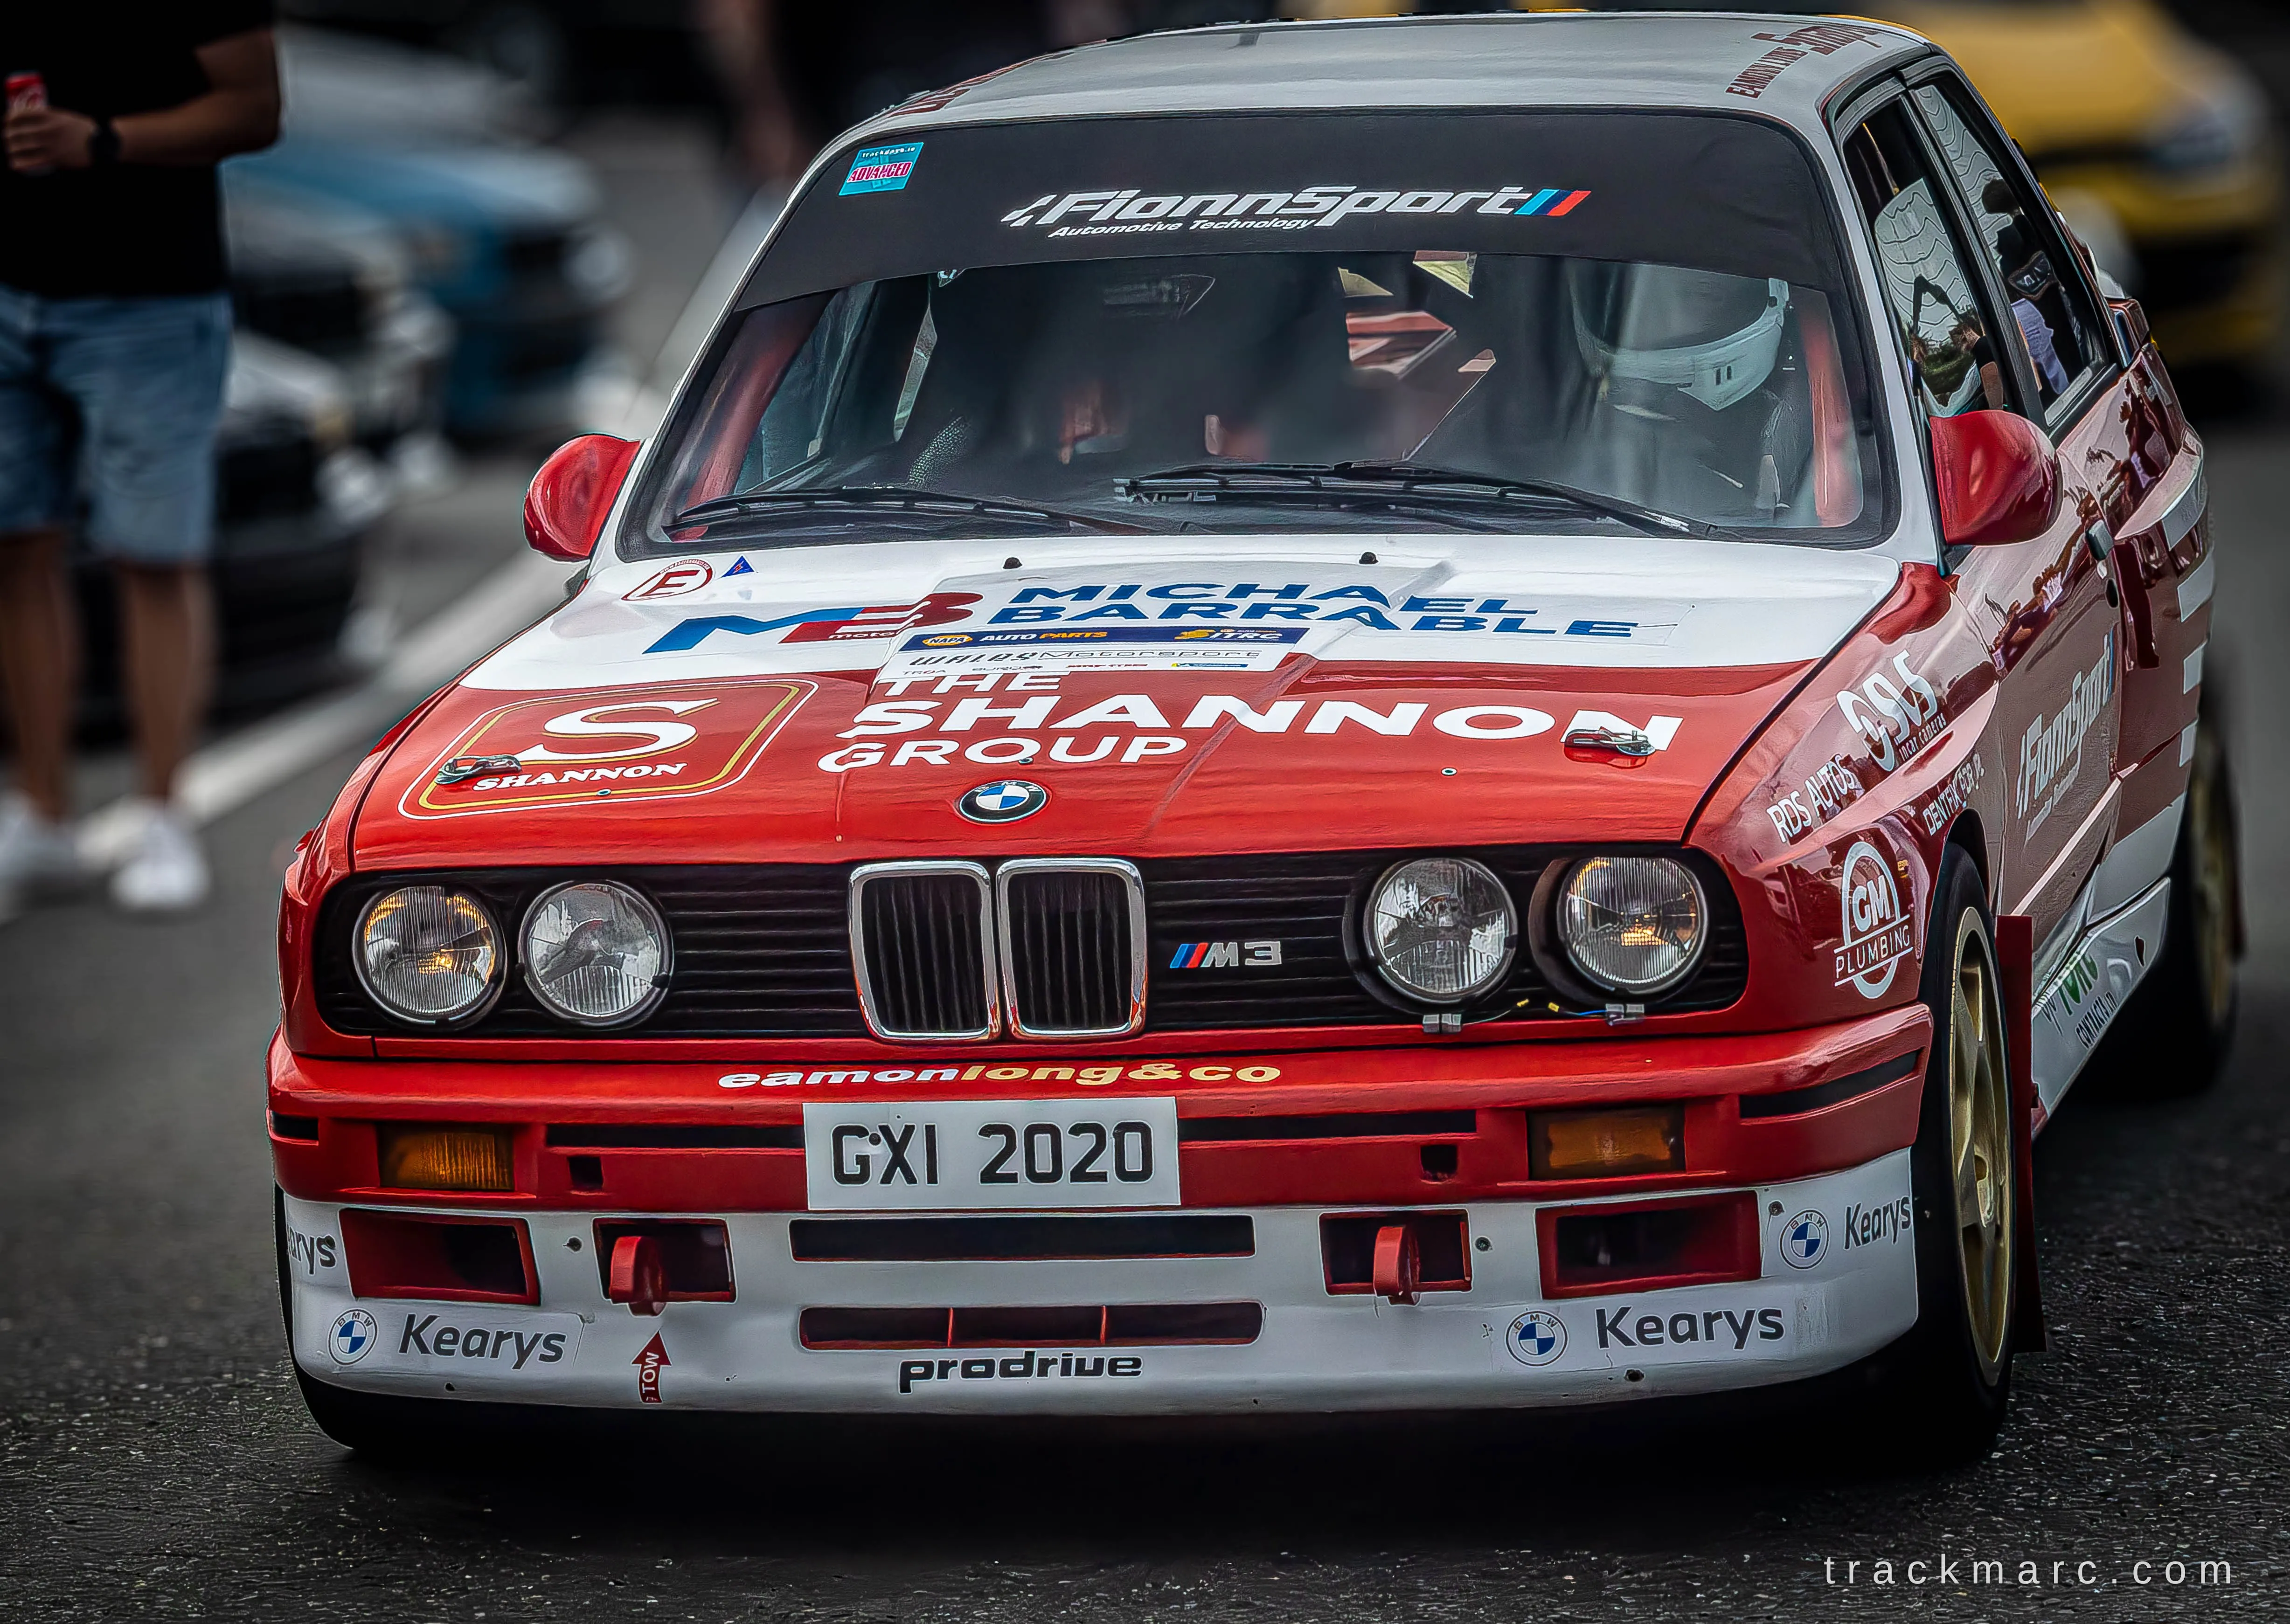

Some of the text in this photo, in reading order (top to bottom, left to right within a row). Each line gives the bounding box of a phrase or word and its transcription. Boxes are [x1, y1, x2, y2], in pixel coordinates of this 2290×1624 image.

[847, 162, 913, 182] ADVANCED
[1035, 185, 1533, 227] FionnSport
[1048, 217, 1317, 238] Automotive Technology
[986, 602, 1638, 637] BARRABLE
[1008, 583, 1538, 615] MICHAEL
[979, 633, 1036, 642] AUTO
[1039, 631, 1108, 639] PARTS
[878, 670, 1071, 696] THE
[515, 698, 720, 764] S
[835, 693, 1684, 751] SHANNON
[1899, 712, 1947, 761] incar cameras
[817, 736, 1187, 773] GROUP
[472, 763, 687, 791] SHANNON
[974, 781, 1041, 793] BMW
[1766, 754, 1855, 843] RDS AUTOS
[1922, 780, 1963, 836] DENTFIX
[1852, 875, 1891, 932] GM
[1200, 941, 1282, 967] M3
[1836, 925, 1910, 979] PLUMBING
[717, 1063, 1282, 1089] eamonlong&co
[832, 1121, 1153, 1186] GXI 2020
[1790, 1196, 1912, 1251] BMW Kearys
[337, 1312, 567, 1370] BMW Kearys
[1513, 1306, 1785, 1350] BMW Kearys
[642, 1352, 659, 1394] TOW
[899, 1350, 1143, 1394] prodrive
